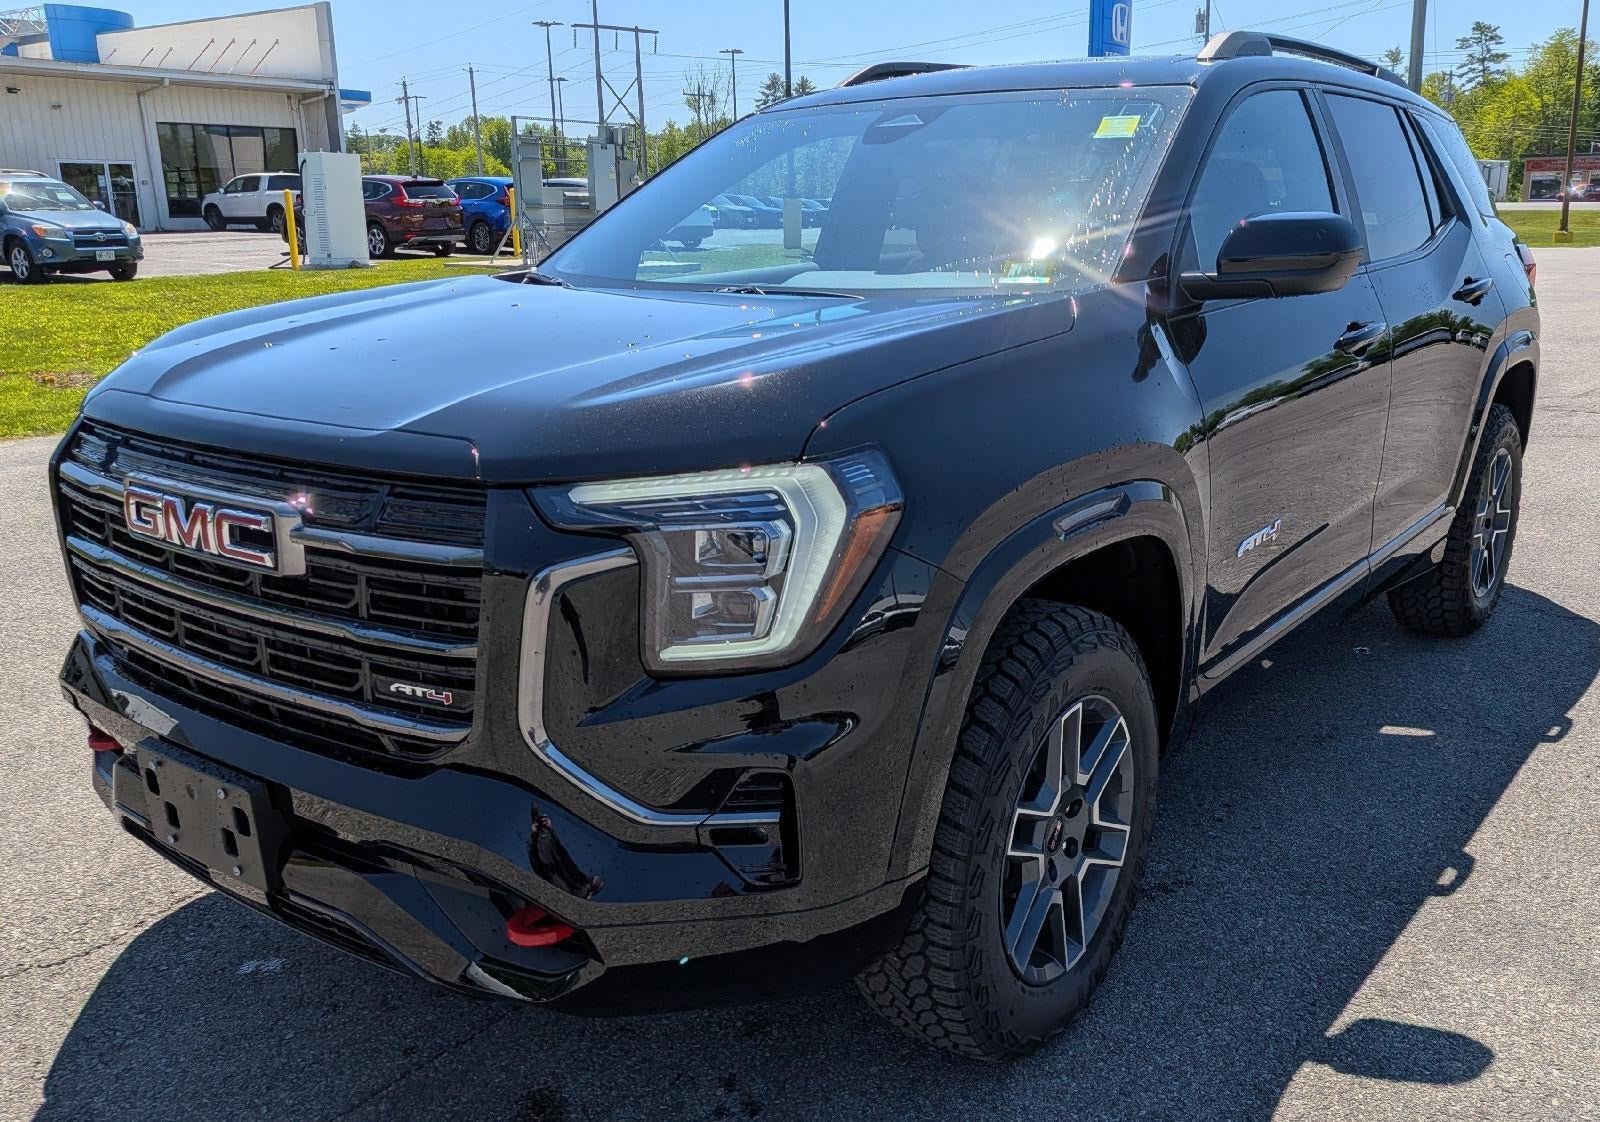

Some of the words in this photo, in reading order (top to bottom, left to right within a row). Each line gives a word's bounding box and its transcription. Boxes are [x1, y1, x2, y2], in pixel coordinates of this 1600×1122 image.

[124, 487, 274, 568] GMC
[1237, 519, 1281, 558] AT4
[390, 682, 453, 706] AT4
